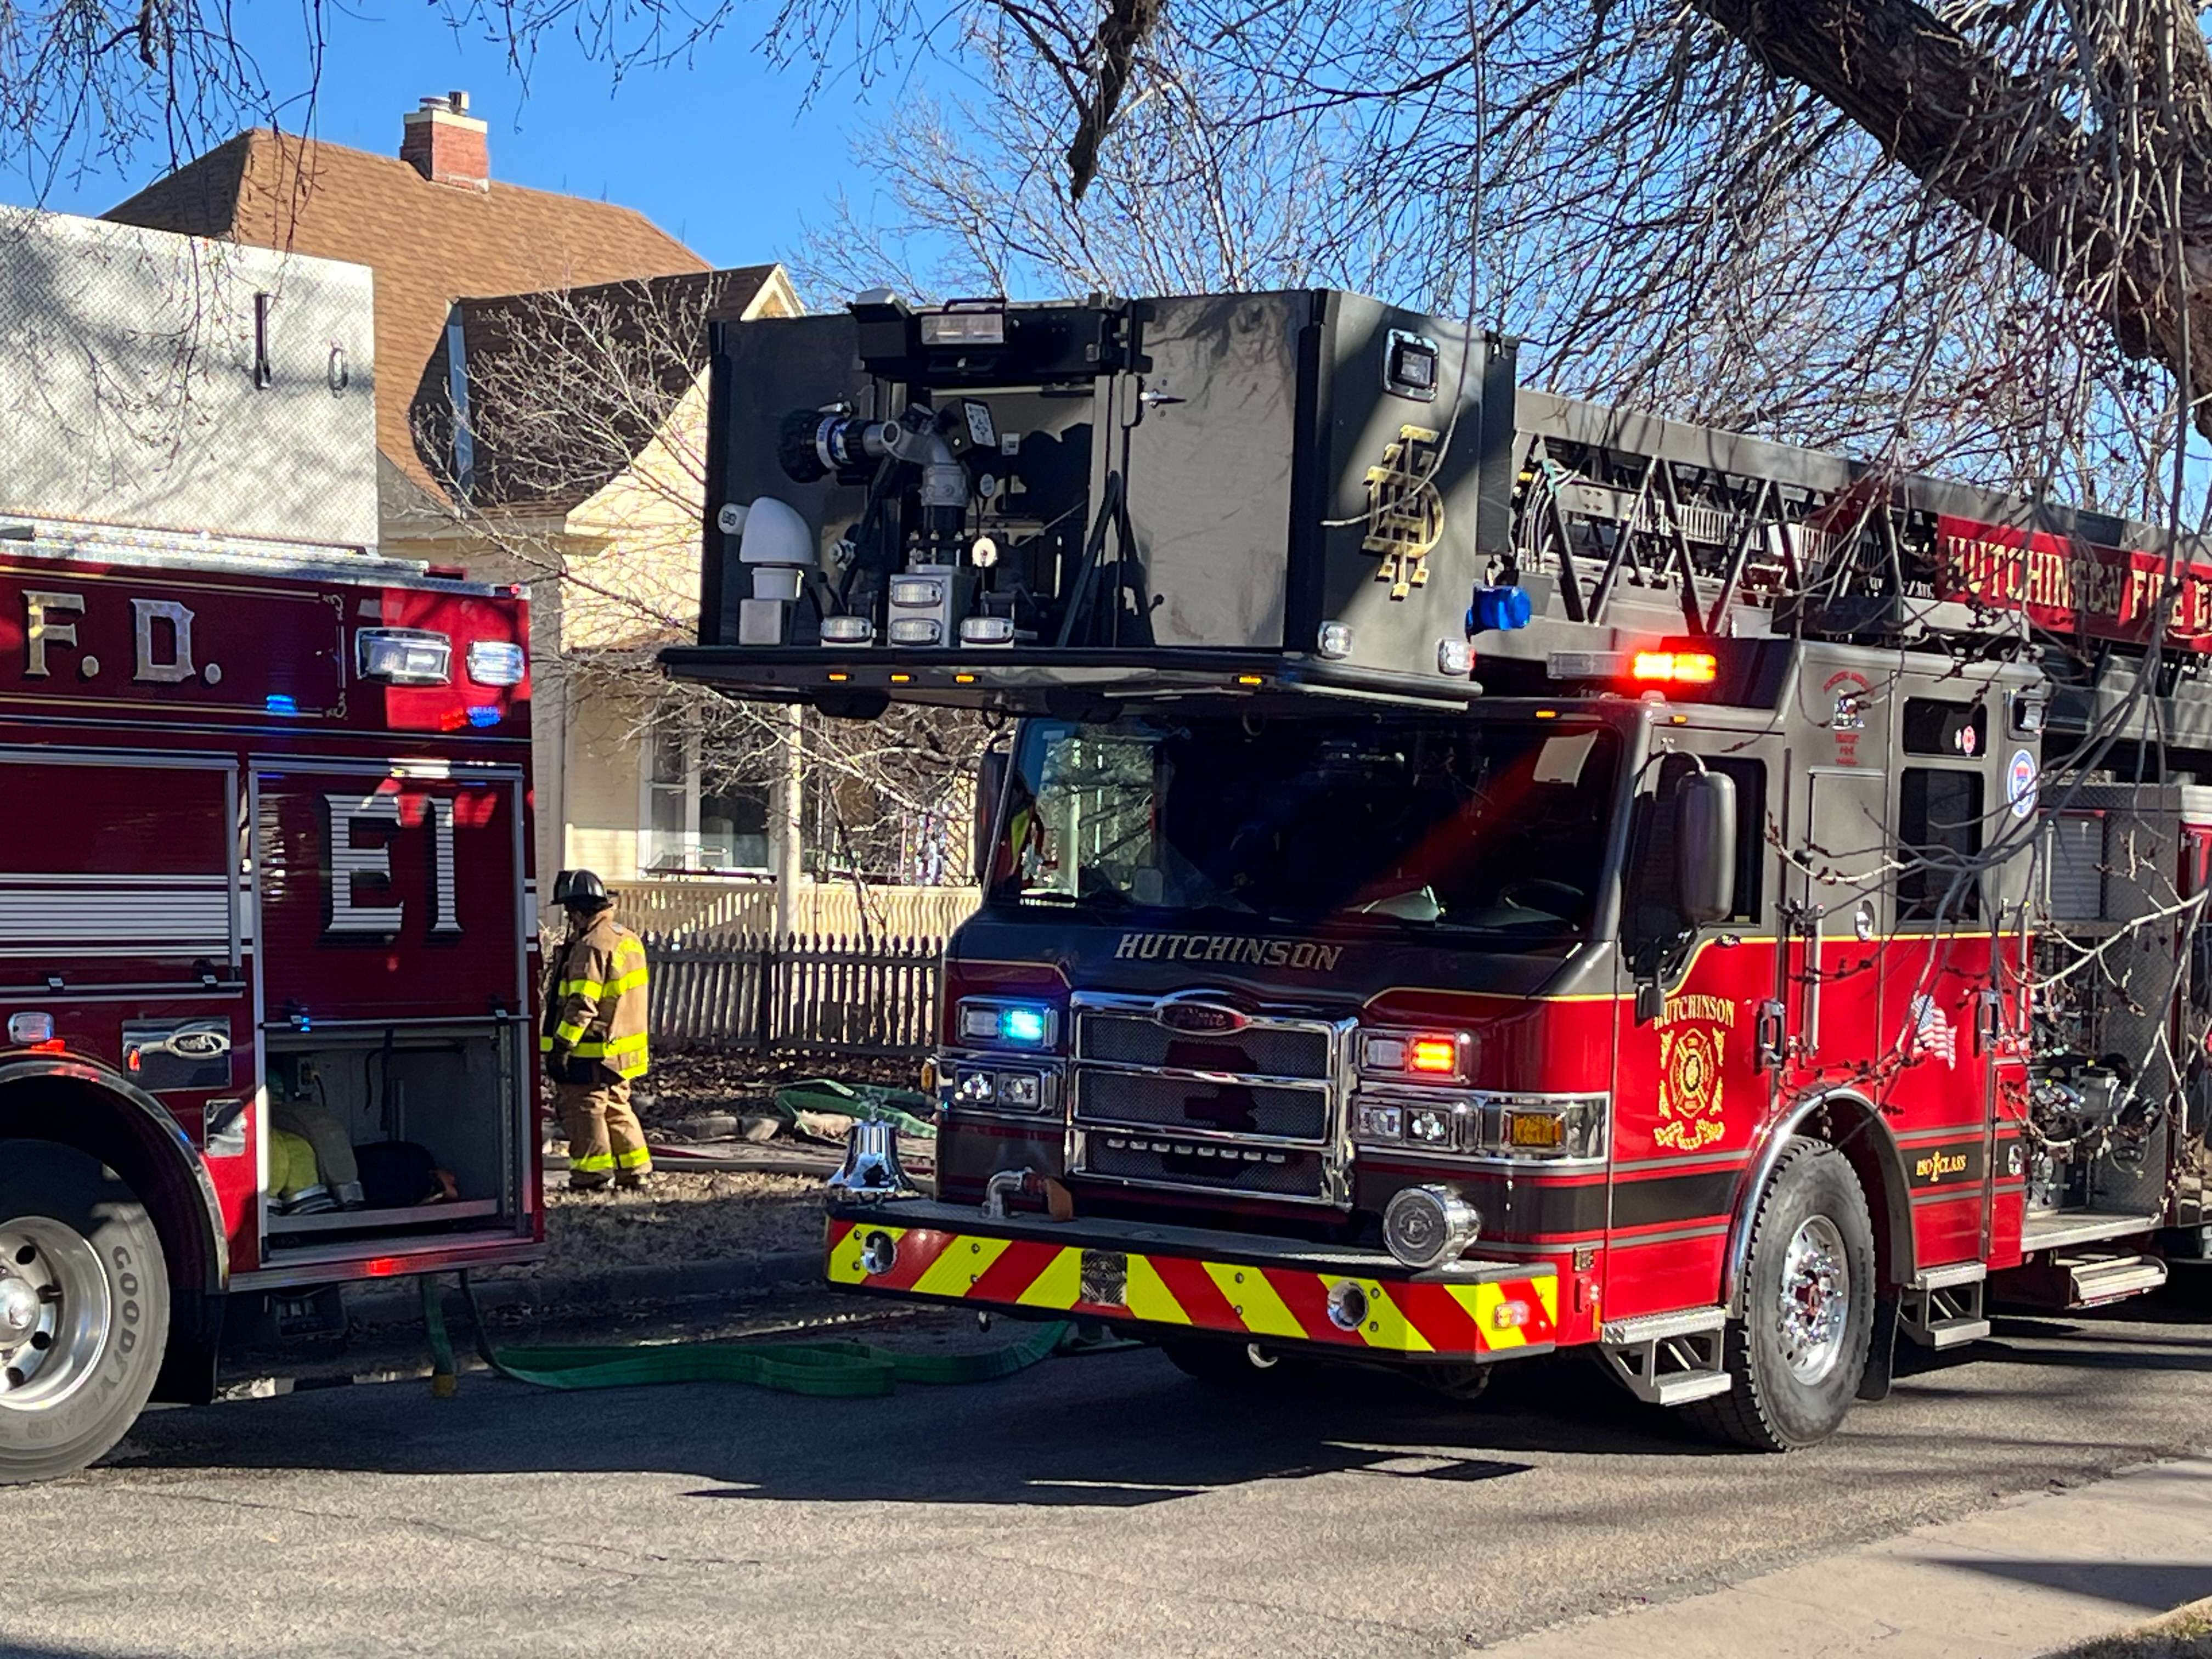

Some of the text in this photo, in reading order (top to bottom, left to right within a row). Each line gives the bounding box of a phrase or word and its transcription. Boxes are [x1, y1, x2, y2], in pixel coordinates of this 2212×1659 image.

[2131, 569, 2184, 626] FIE
[21, 589, 222, 685] F. D.
[1113, 933, 1344, 972] HUTCHINSON
[1939, 1154, 1967, 1173] CLASS
